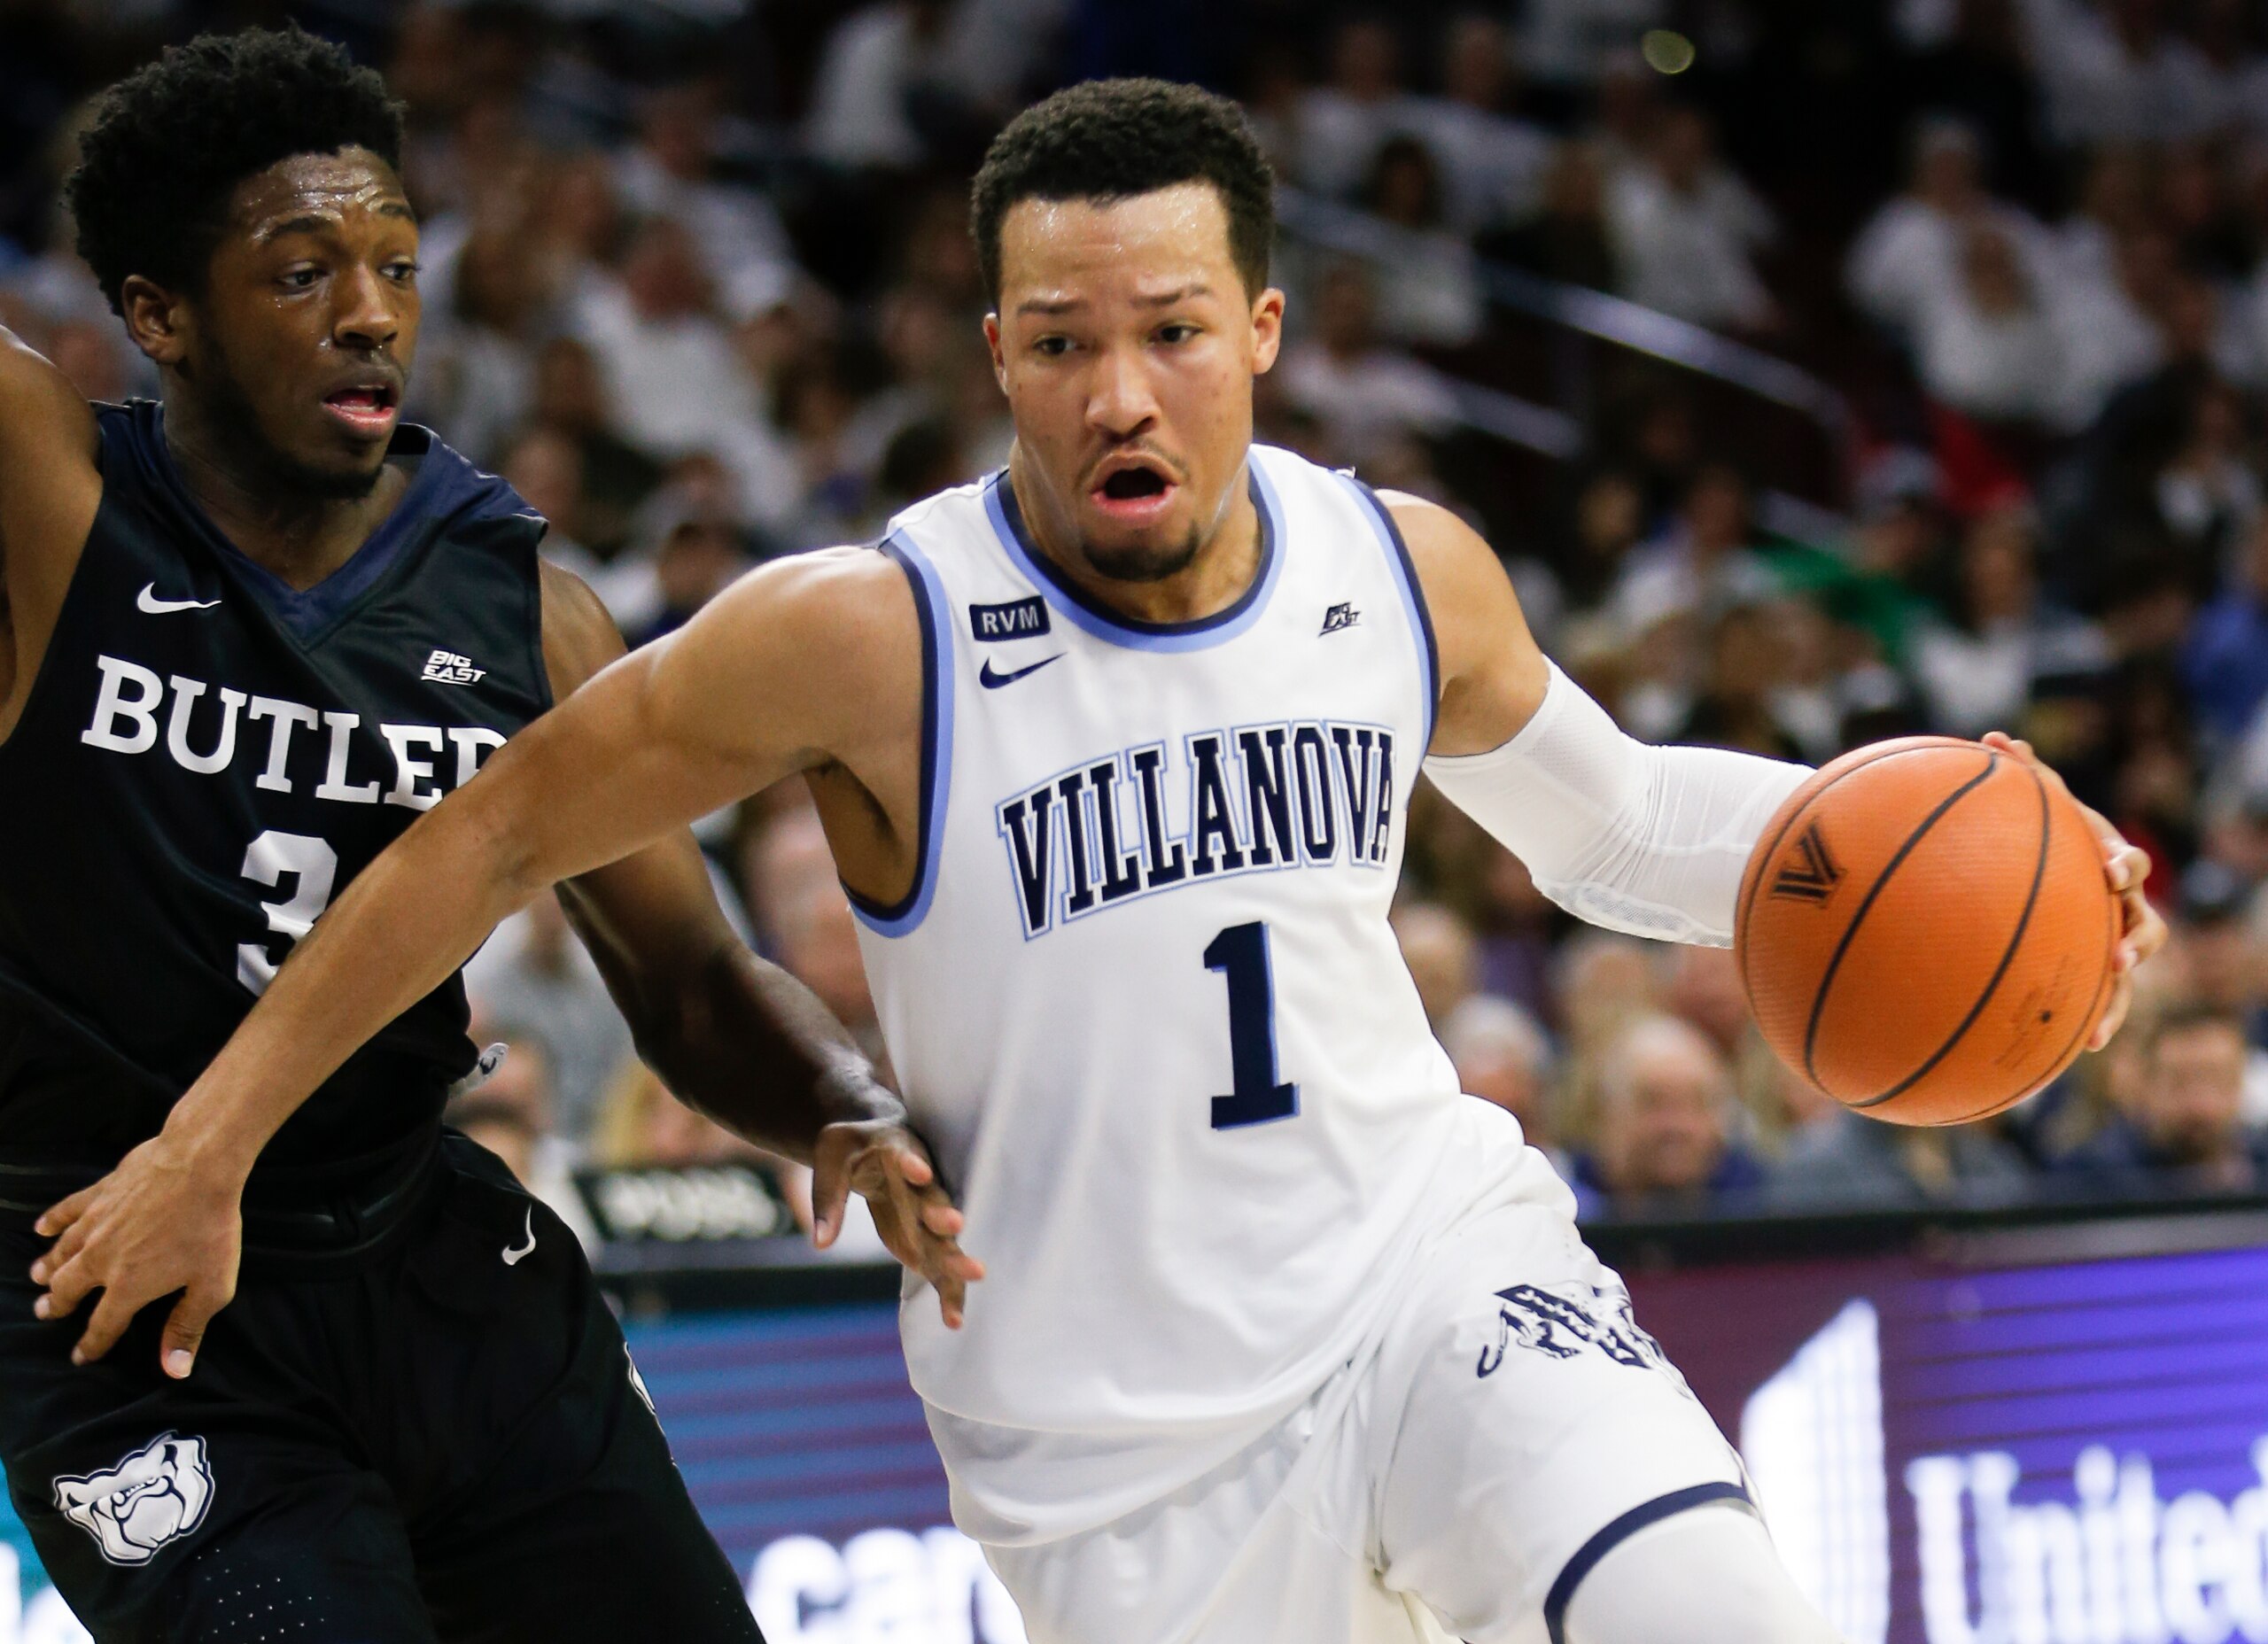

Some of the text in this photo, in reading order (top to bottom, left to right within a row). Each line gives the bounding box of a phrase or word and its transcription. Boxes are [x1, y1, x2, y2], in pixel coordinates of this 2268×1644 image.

[982, 606, 1040, 634] RVM
[428, 649, 471, 668] BIG
[423, 664, 486, 682] EAST
[995, 719, 1395, 942] VILLANOVA
[1202, 920, 1301, 1131] 1
